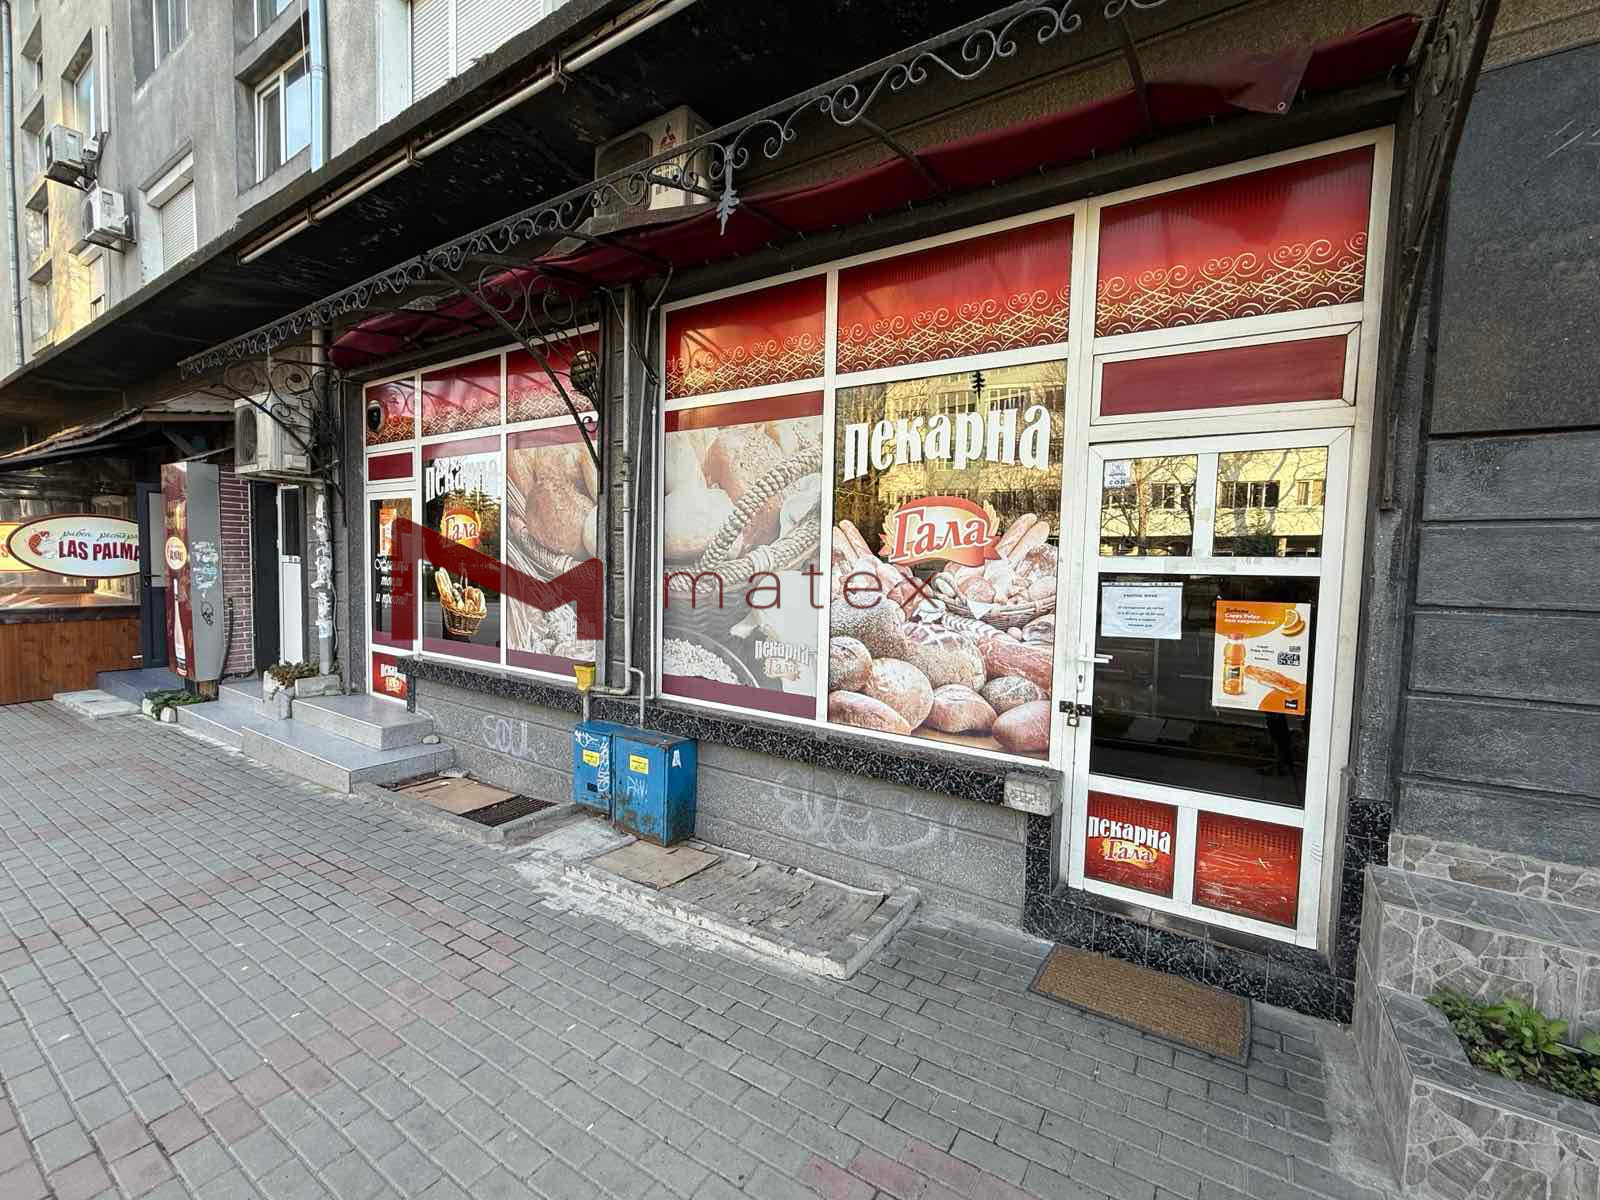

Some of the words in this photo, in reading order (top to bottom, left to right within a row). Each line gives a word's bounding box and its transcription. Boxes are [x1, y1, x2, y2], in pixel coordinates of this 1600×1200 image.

[843, 404, 1052, 482] пекарна
[58, 539, 88, 561] LAS
[888, 506, 989, 564] Гала
[754, 639, 809, 665] пекарна
[1087, 815, 1171, 855] пекарна
[1105, 839, 1154, 862] Гала
